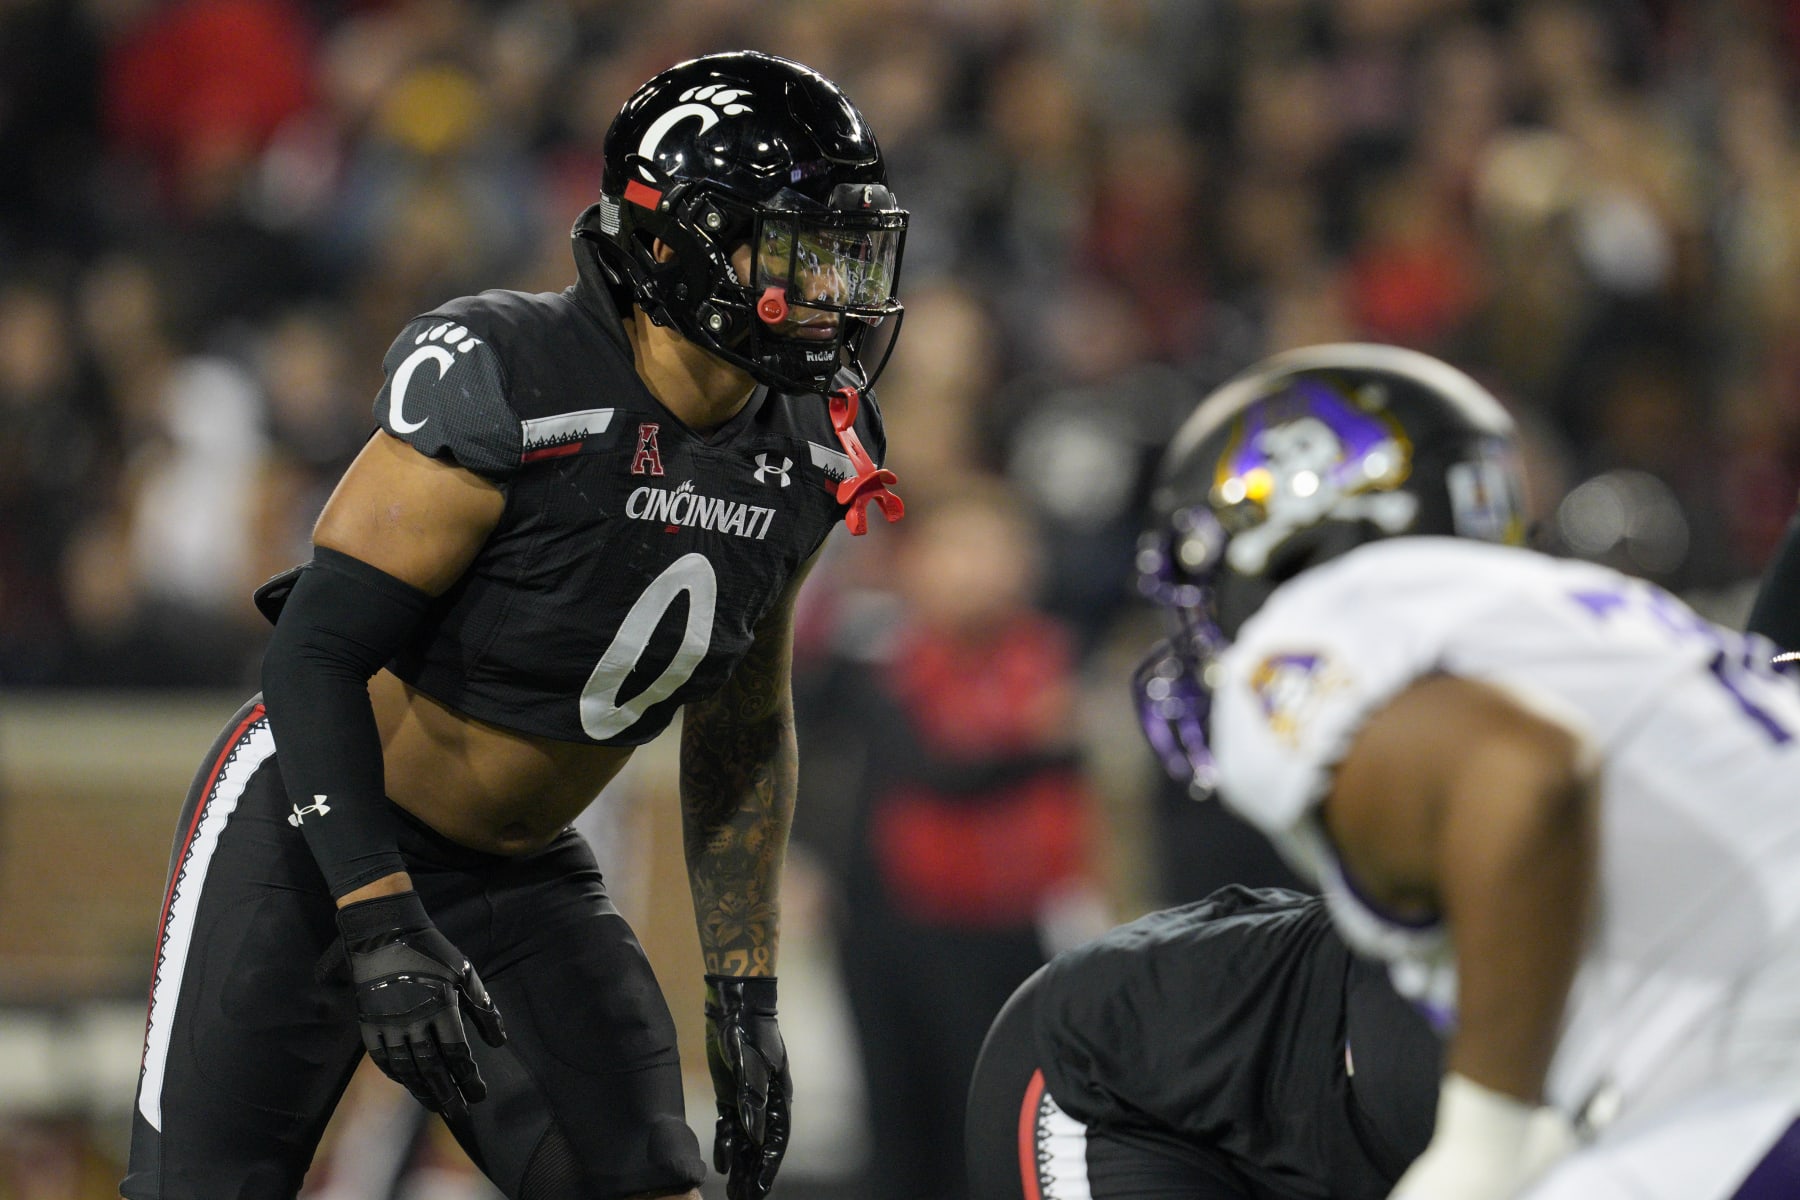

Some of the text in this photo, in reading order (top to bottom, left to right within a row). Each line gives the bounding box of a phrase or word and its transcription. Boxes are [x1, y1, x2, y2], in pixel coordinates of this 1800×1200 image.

[388, 345, 455, 433] C
[631, 423, 665, 476] A
[625, 484, 777, 540] CINCINNATI
[580, 552, 717, 740] 0
